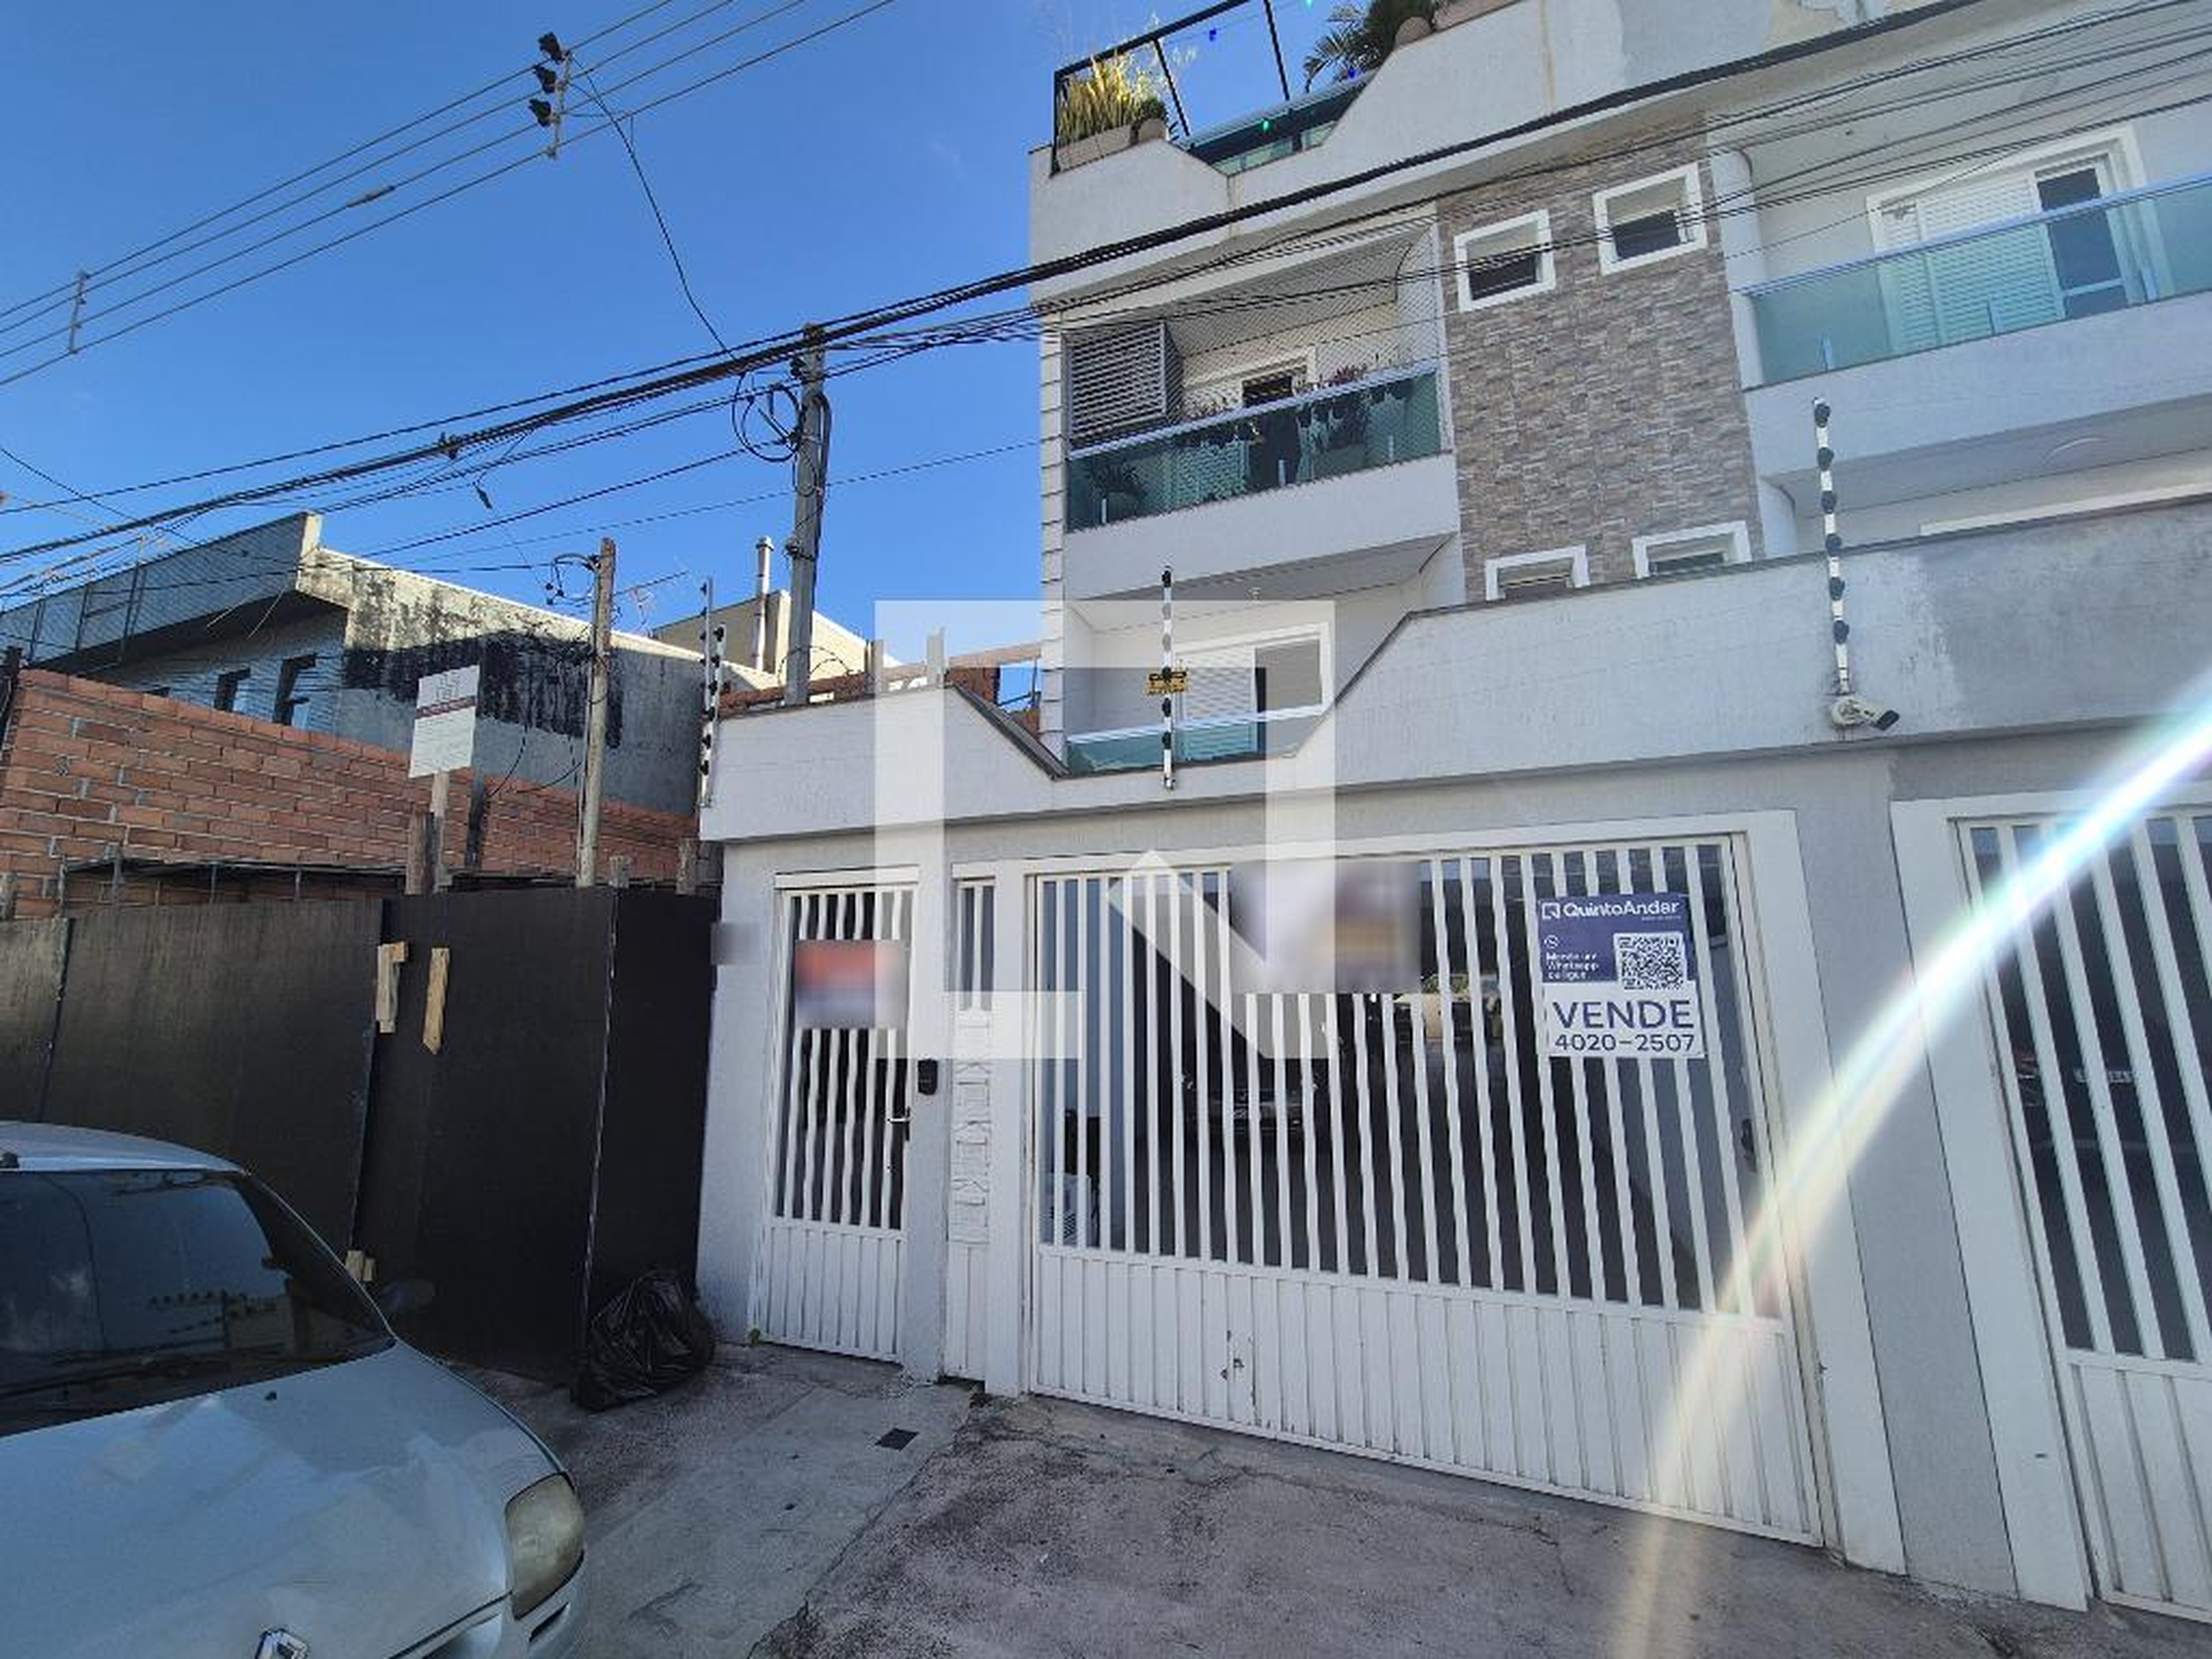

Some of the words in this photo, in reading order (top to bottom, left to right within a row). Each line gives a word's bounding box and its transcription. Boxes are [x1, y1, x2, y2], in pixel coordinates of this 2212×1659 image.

[1563, 900, 1679, 917] QuintoAndar
[1552, 999, 1694, 1029] VENDE
[1555, 1034, 1695, 1051] 4020-2507
